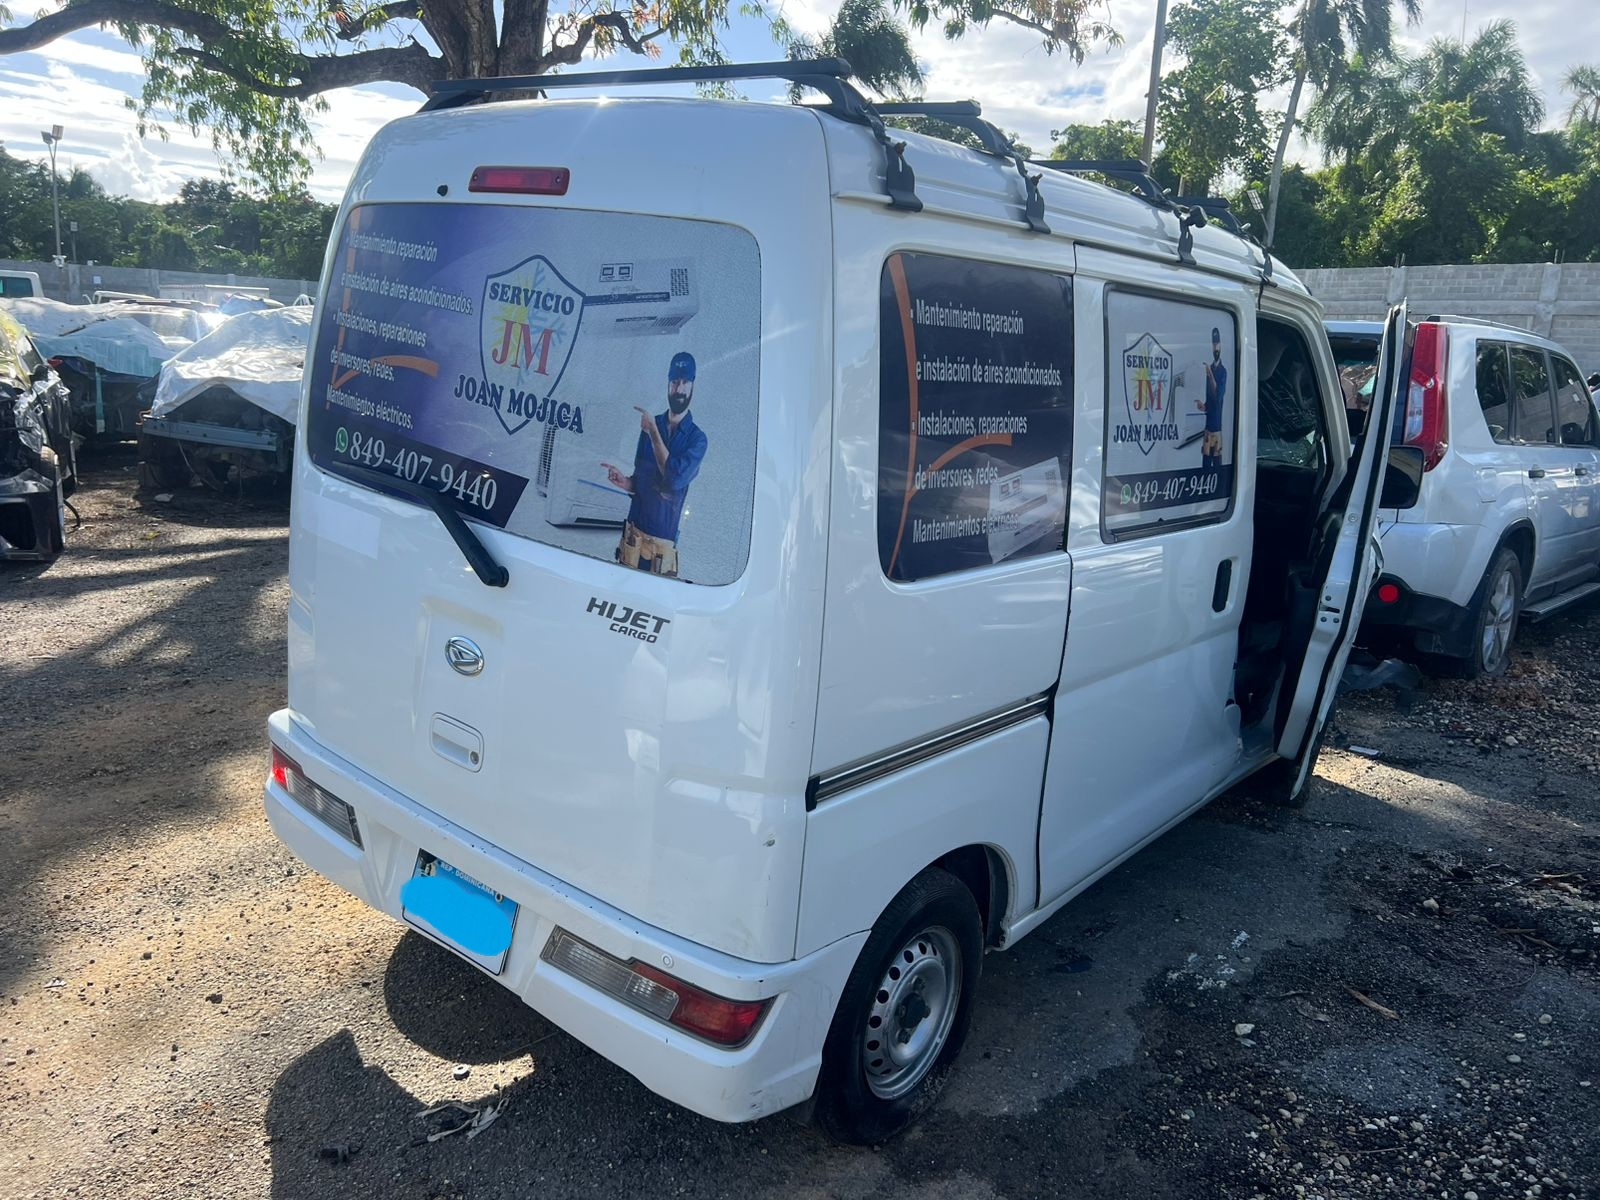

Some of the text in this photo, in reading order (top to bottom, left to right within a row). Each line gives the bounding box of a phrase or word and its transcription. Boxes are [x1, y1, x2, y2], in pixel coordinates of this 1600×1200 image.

[351, 230, 438, 262] Mantenimiento reparación
[346, 271, 379, 294] instalación
[380, 275, 389, 295] de
[390, 278, 408, 299] aires
[408, 284, 473, 315] acondicionados.
[489, 282, 575, 316] SERVICIO
[336, 307, 427, 348] Instalaciones, reparaciones
[916, 299, 1024, 338] Mantenimiento reparación
[330, 345, 395, 382] de inversores, redes.
[491, 319, 556, 376] JM
[1126, 354, 1169, 370] SERVICIO
[916, 354, 1062, 386] e instalación de aires acondicionados.
[326, 383, 414, 430] Mantenimientos eléctricos.
[454, 374, 583, 434] JOAN MOJICA
[1133, 379, 1163, 411] JM
[918, 410, 1028, 438] Instalaciones, reparaciones
[1114, 422, 1179, 443] JOAN MOJICA
[350, 431, 497, 510] 849-407-9440
[915, 464, 927, 490] de
[928, 464, 975, 489] inversores,
[1133, 472, 1217, 504] 849-407-9440
[913, 515, 980, 543] Mantenimientos
[586, 597, 671, 634] HIJET
[609, 623, 658, 643] CARGO
[455, 870, 494, 896] DOMINICANA
